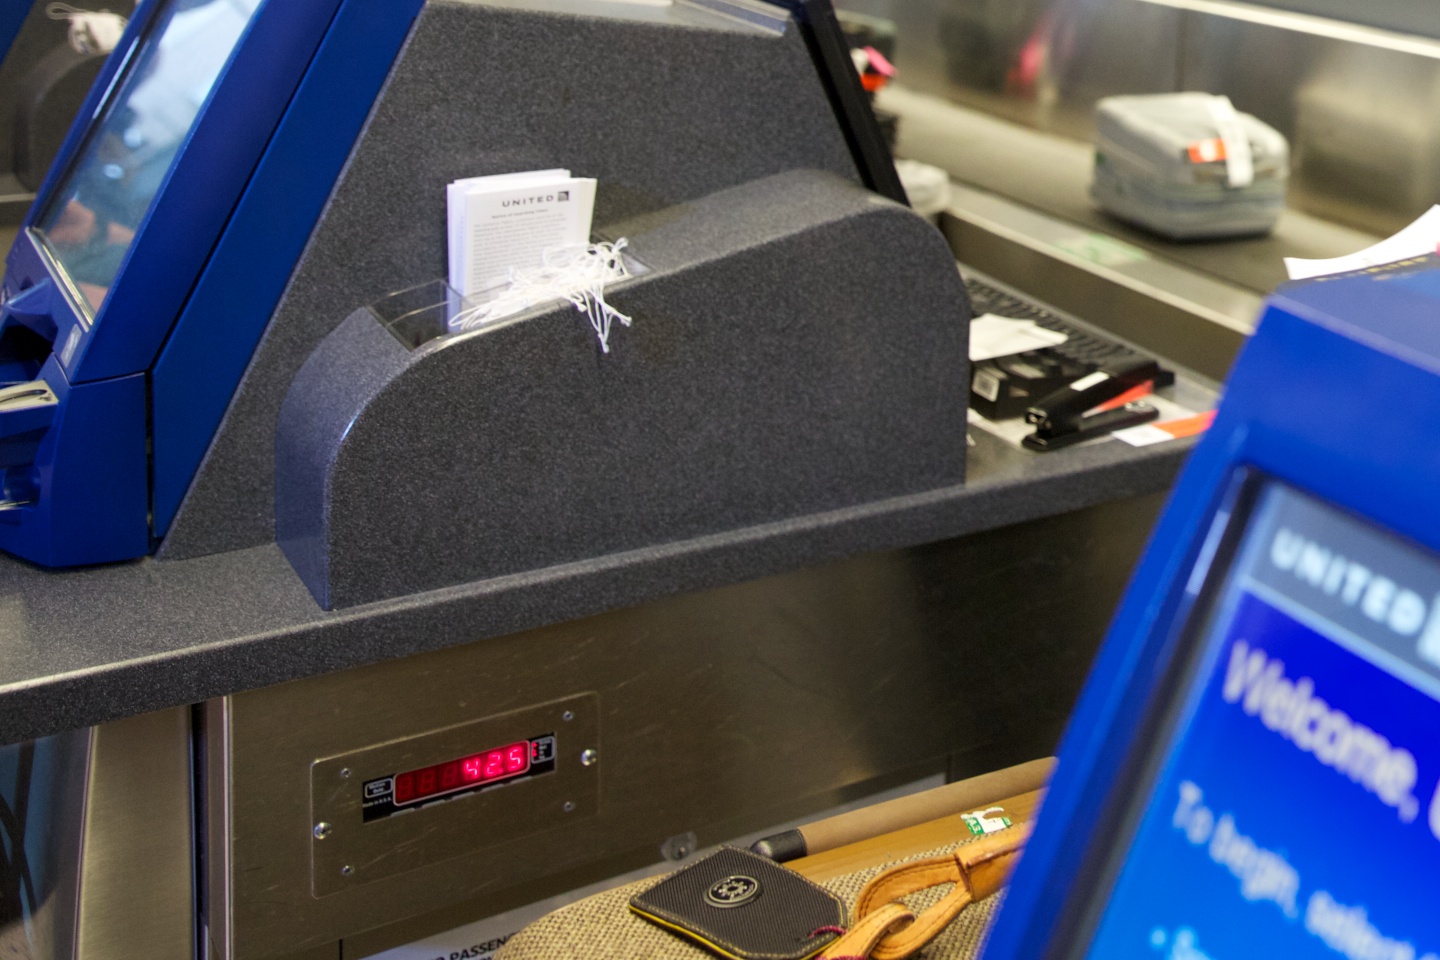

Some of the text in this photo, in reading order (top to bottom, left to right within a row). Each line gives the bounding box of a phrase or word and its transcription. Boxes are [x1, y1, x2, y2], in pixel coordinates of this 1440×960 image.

[502, 194, 554, 208] UNITED
[1270, 527, 1427, 637] UNITED
[1222, 639, 1420, 824] Welcome,
[1172, 780, 1215, 844] To
[1208, 812, 1300, 921] begin,
